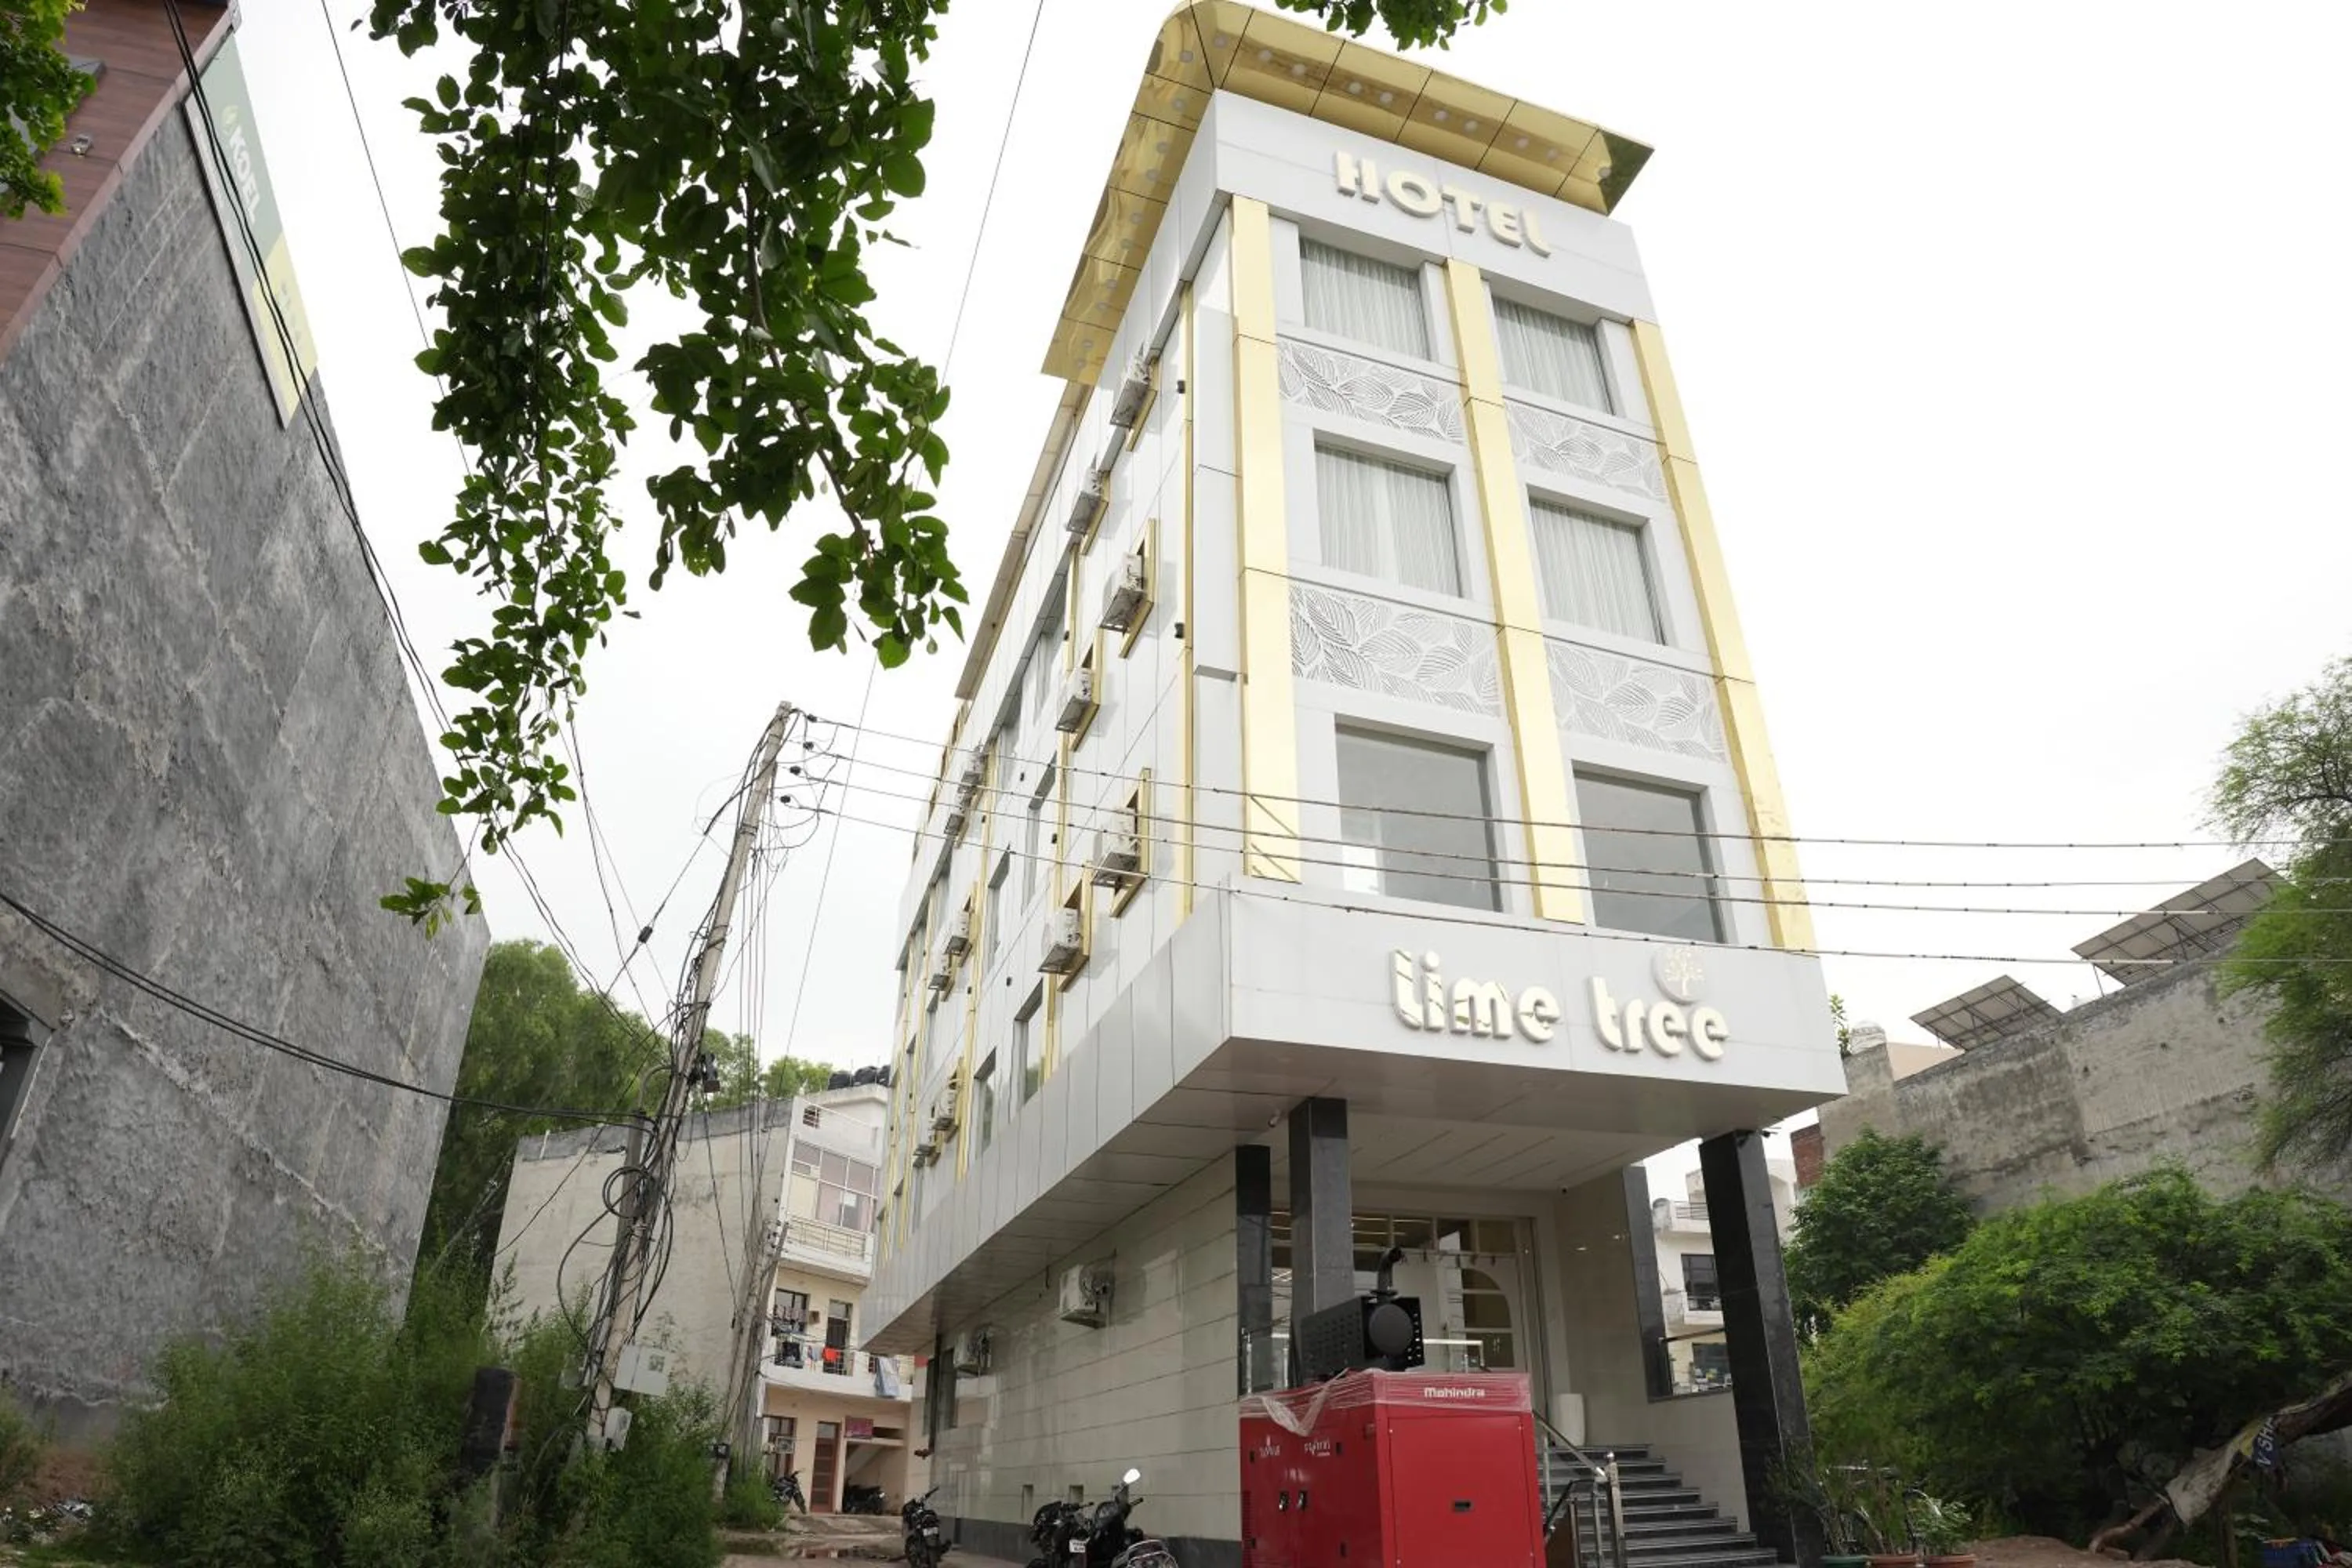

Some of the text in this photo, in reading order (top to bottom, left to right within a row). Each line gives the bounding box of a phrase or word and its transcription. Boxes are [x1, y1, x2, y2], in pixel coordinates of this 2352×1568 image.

[229, 125, 260, 224] KOEL
[1334, 149, 1552, 258] HOTEL
[1388, 948, 1730, 1061] lime tree
[1423, 1387, 1486, 1399] Mahindra
